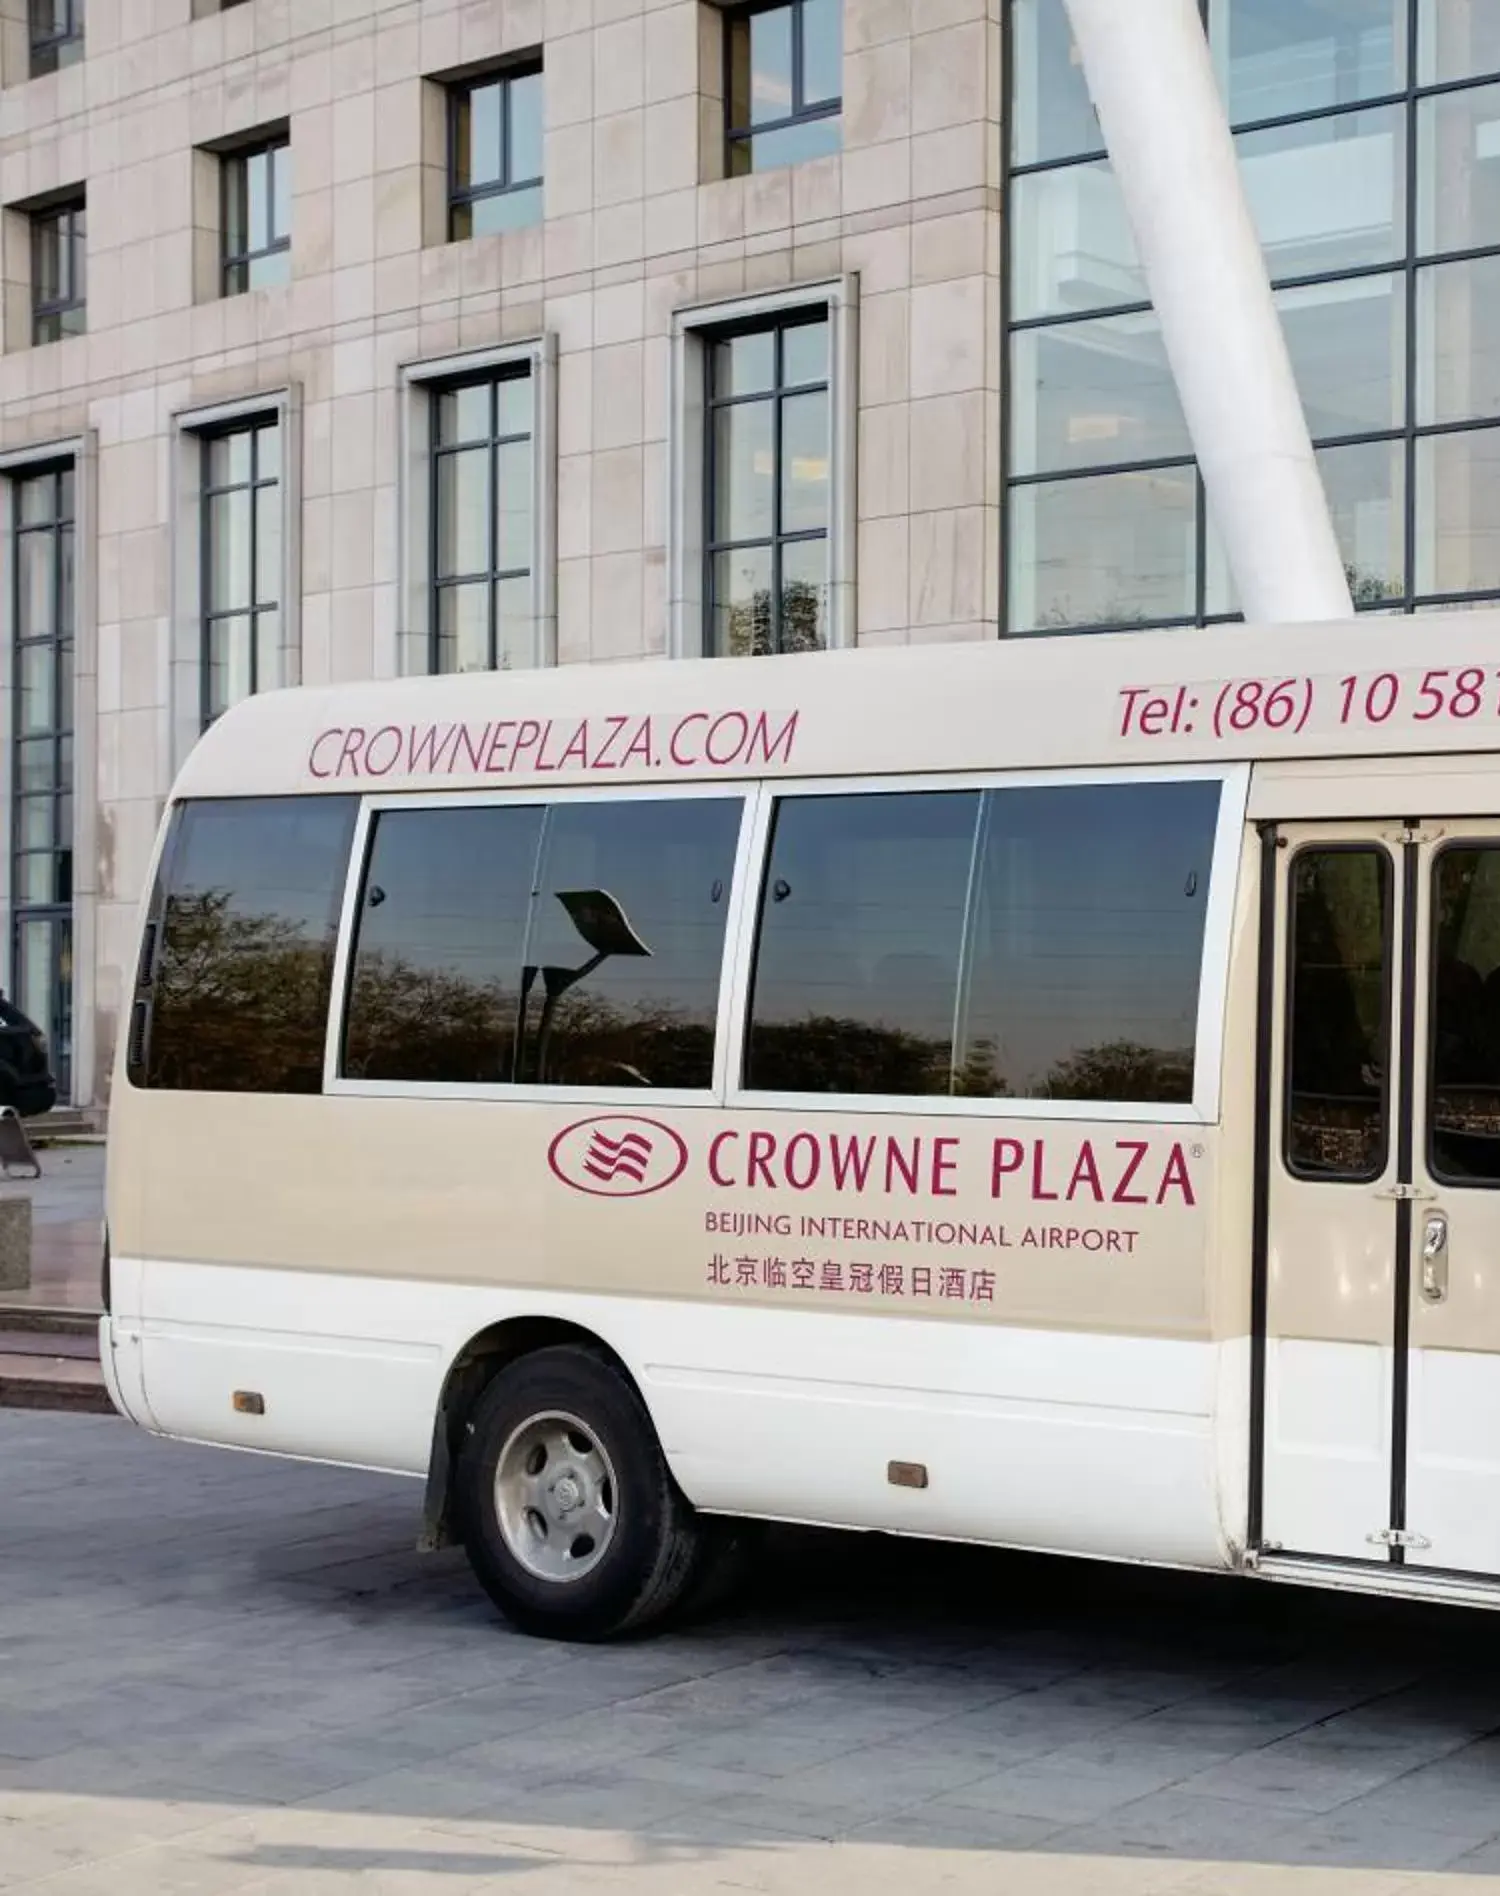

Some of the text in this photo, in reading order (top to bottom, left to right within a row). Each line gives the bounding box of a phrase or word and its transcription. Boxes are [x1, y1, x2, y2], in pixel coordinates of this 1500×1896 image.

[1118, 686, 1199, 737] Tel:
[1213, 677, 1314, 738] (86)
[1340, 672, 1400, 724] 10
[308, 709, 800, 778] CROWNEPLAZA.COM
[708, 1129, 962, 1199] CROWNE
[705, 1211, 1140, 1253] BEIJING INTERNATIONAL AIRPORT
[706, 1252, 997, 1302] 北京临空皇冠假日酒店
